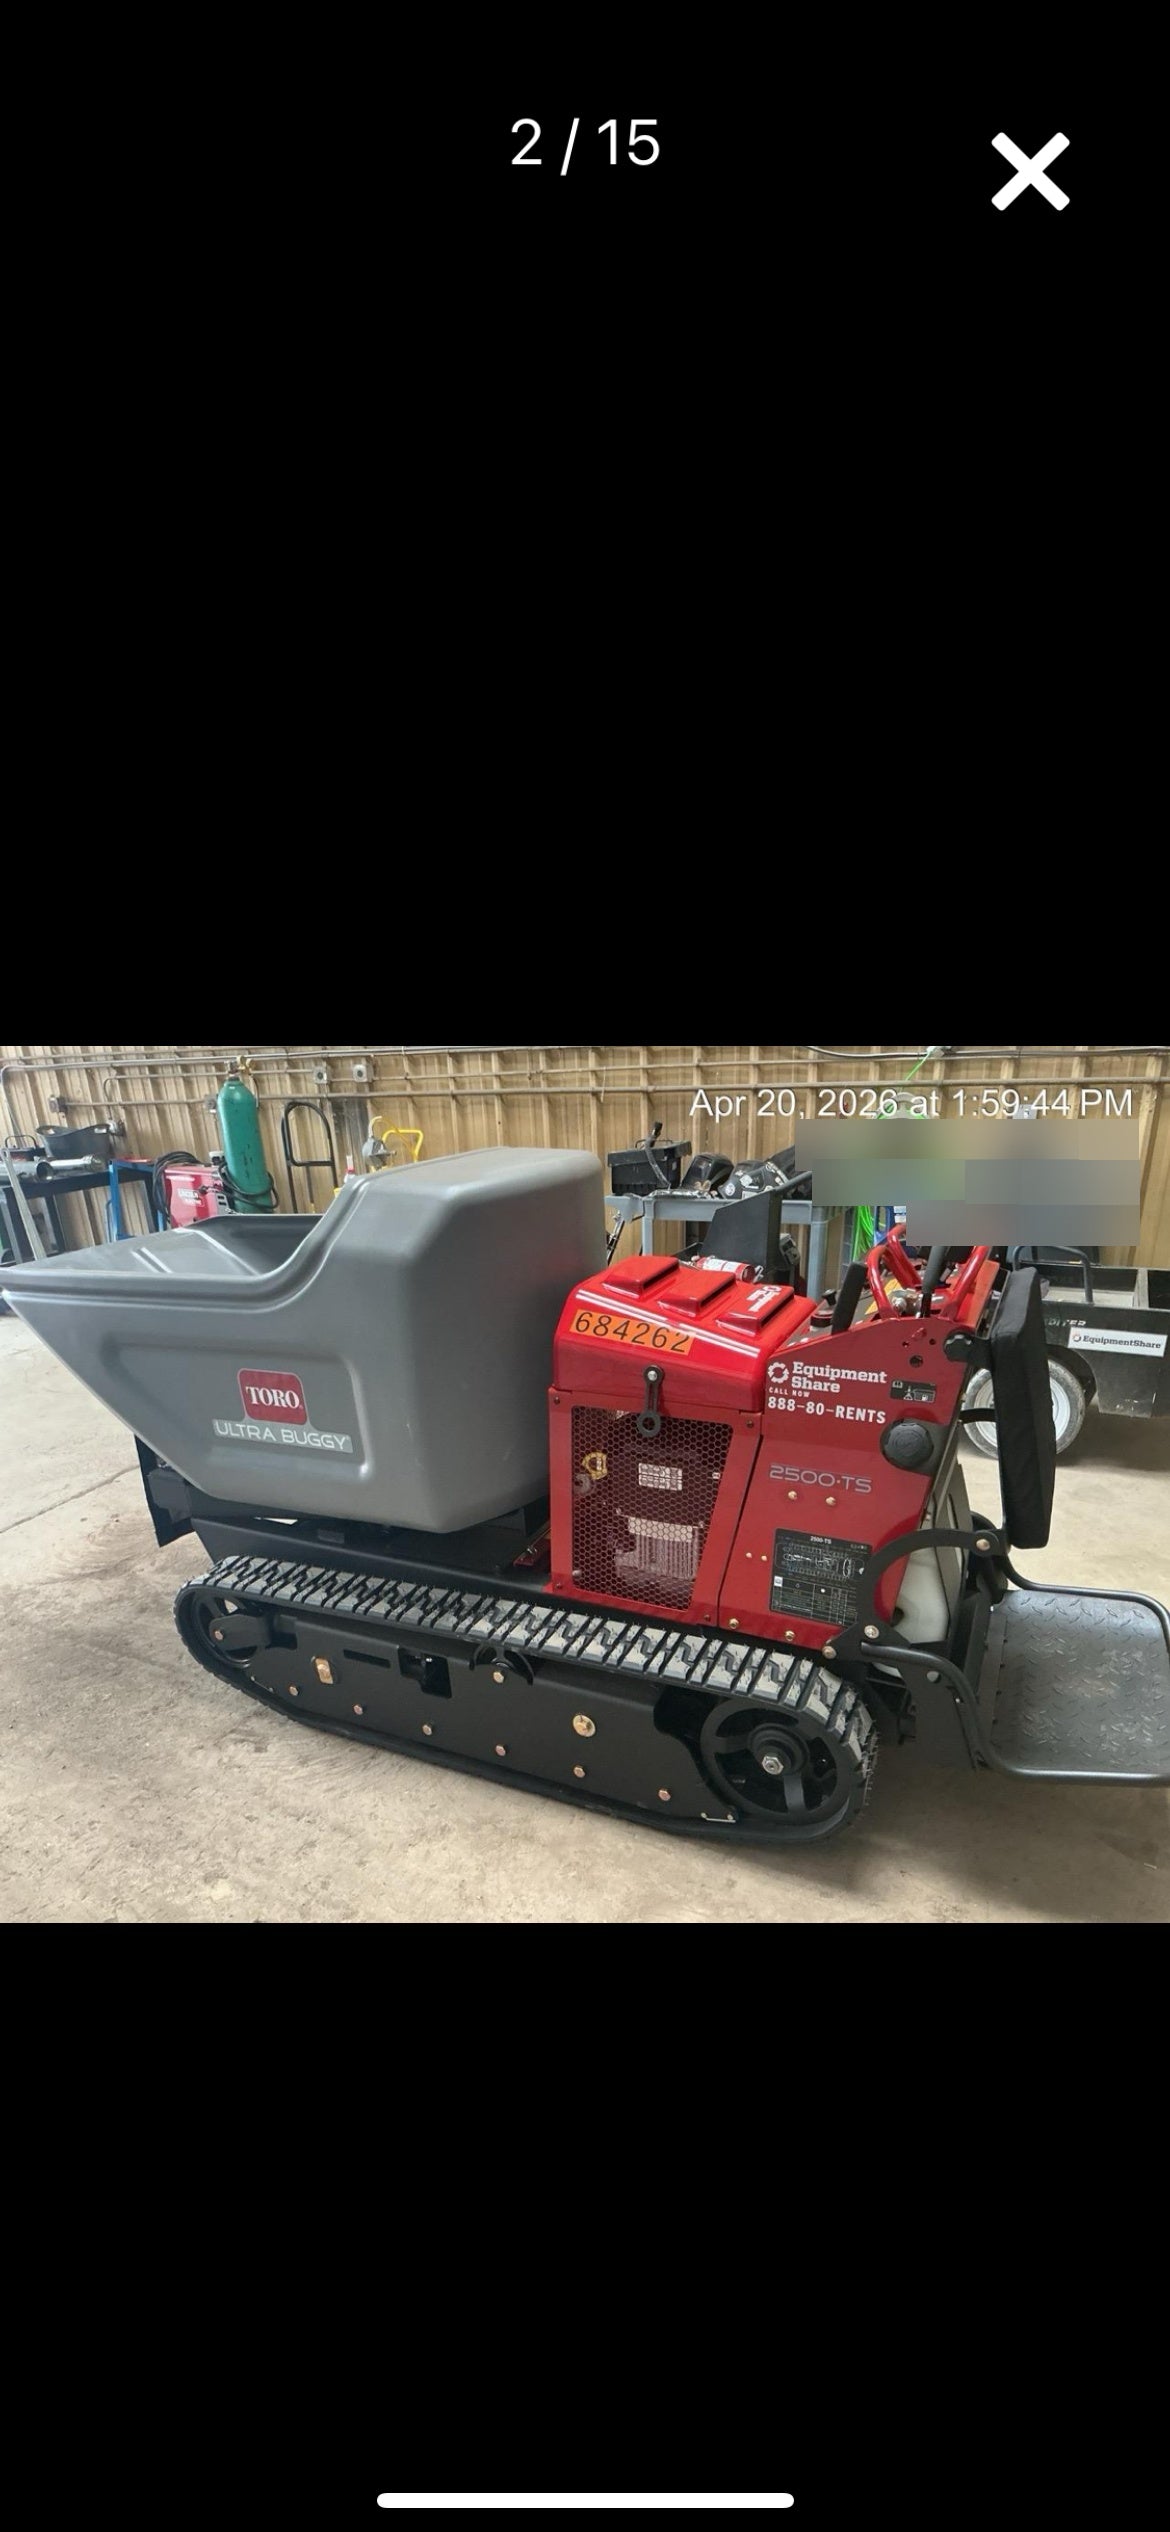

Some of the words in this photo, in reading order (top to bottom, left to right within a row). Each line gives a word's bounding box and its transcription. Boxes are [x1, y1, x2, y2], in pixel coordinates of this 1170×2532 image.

[575, 1311, 690, 1353] 684262
[1082, 1334, 1161, 1349] EquipmentShare
[791, 1376, 841, 1393] Share
[792, 1361, 888, 1384] Equipment
[245, 1385, 301, 1410] TORO
[768, 1386, 789, 1396] CALL
[792, 1389, 811, 1398] NOW
[767, 1396, 887, 1424] 888-80-RENTS
[213, 1420, 277, 1442] ULTRA
[280, 1428, 347, 1450] BUGGY
